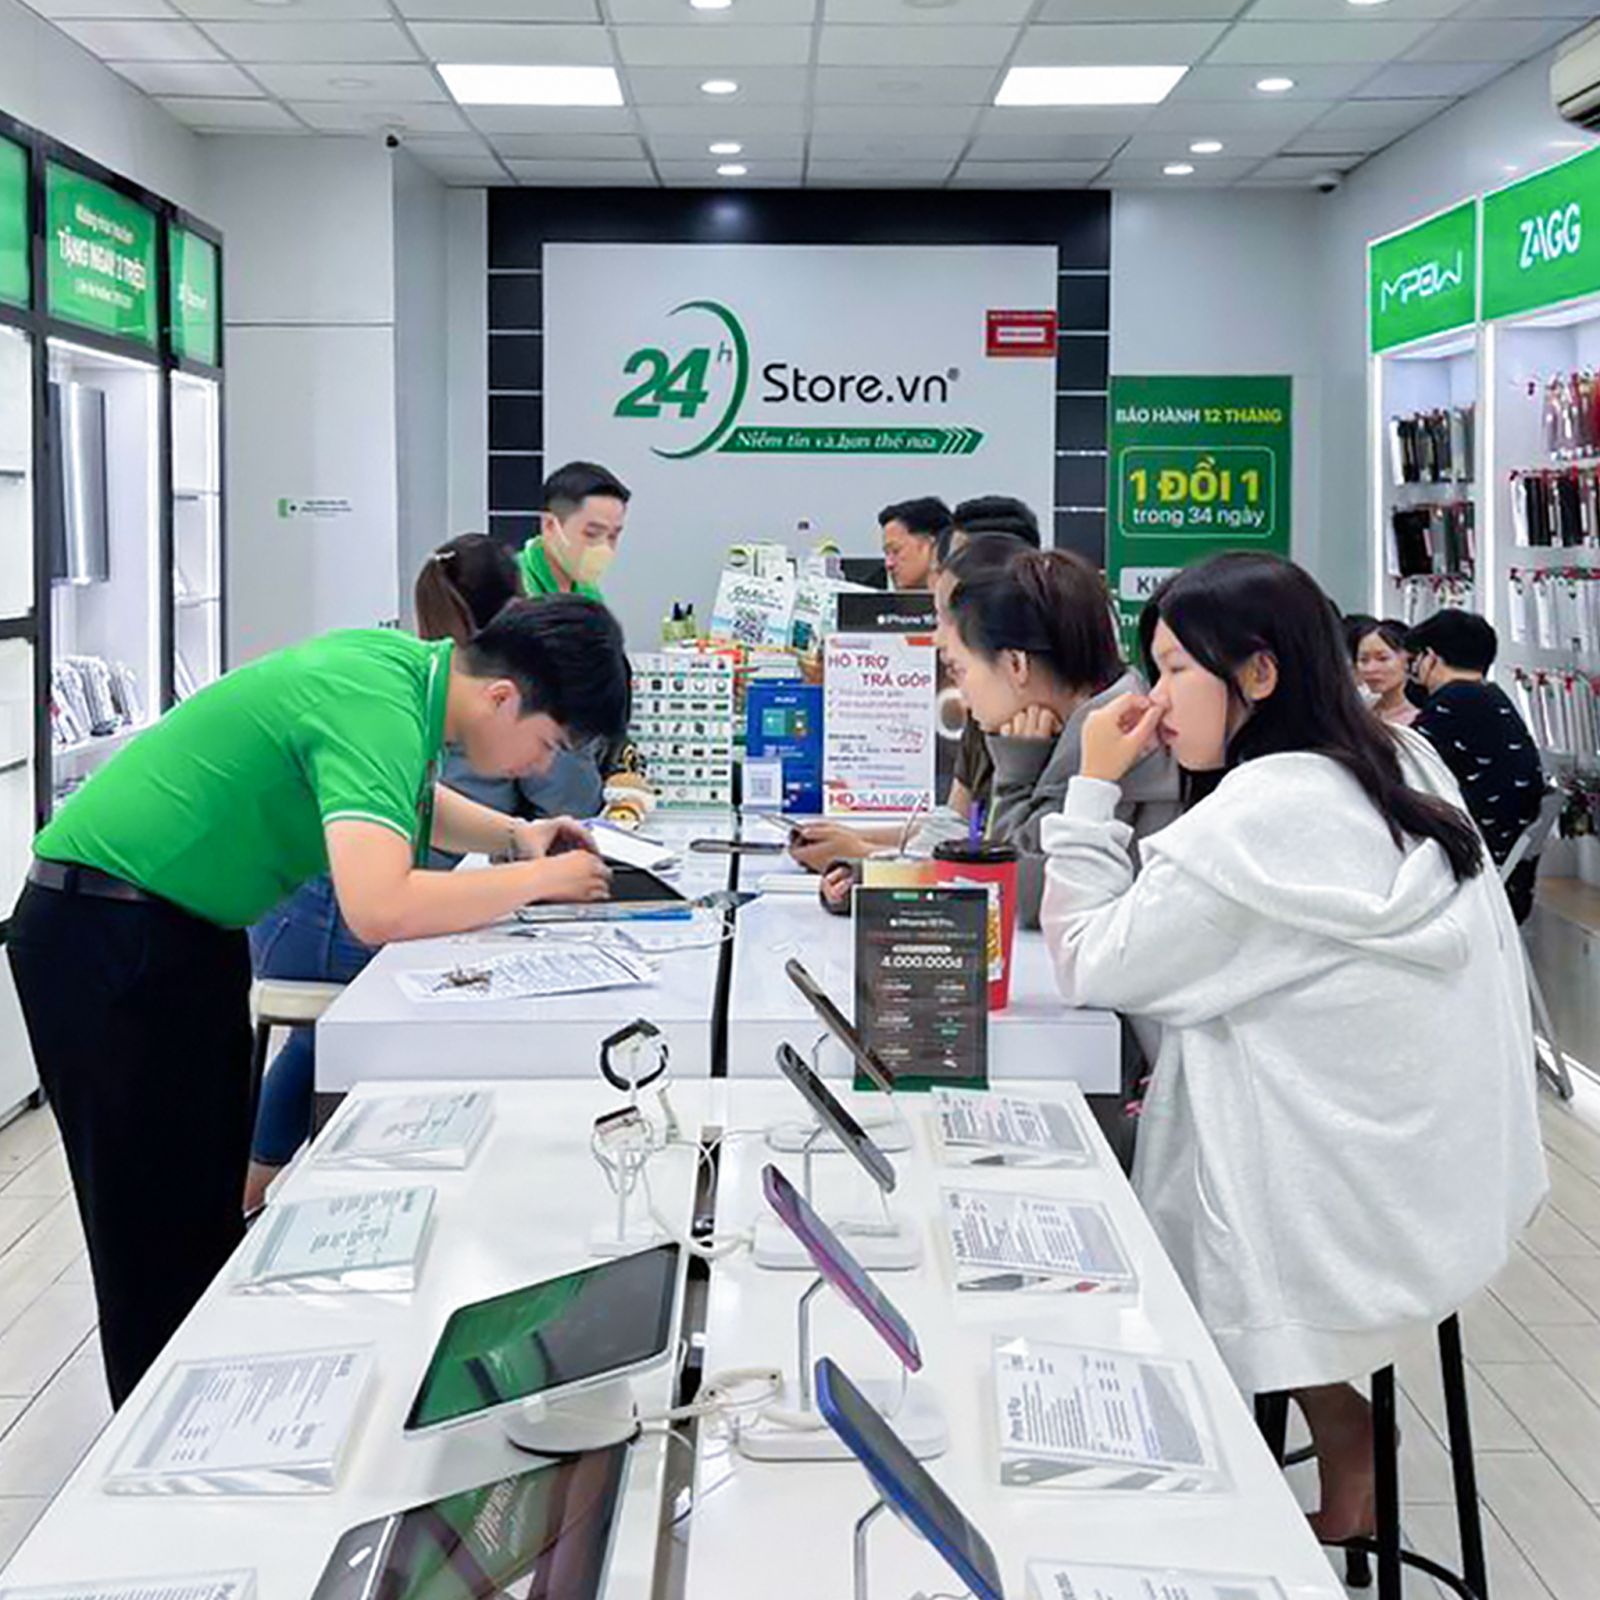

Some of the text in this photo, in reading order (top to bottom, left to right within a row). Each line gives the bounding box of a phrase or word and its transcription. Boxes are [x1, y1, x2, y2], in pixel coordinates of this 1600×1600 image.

[1519, 203, 1580, 269] ZAGG
[1116, 406, 1282, 423] BẢO HÀNH 12 THÁNG
[1129, 468, 1147, 501] 1
[1241, 469, 1259, 502] 1
[1133, 507, 1265, 528] trong 34 ngày
